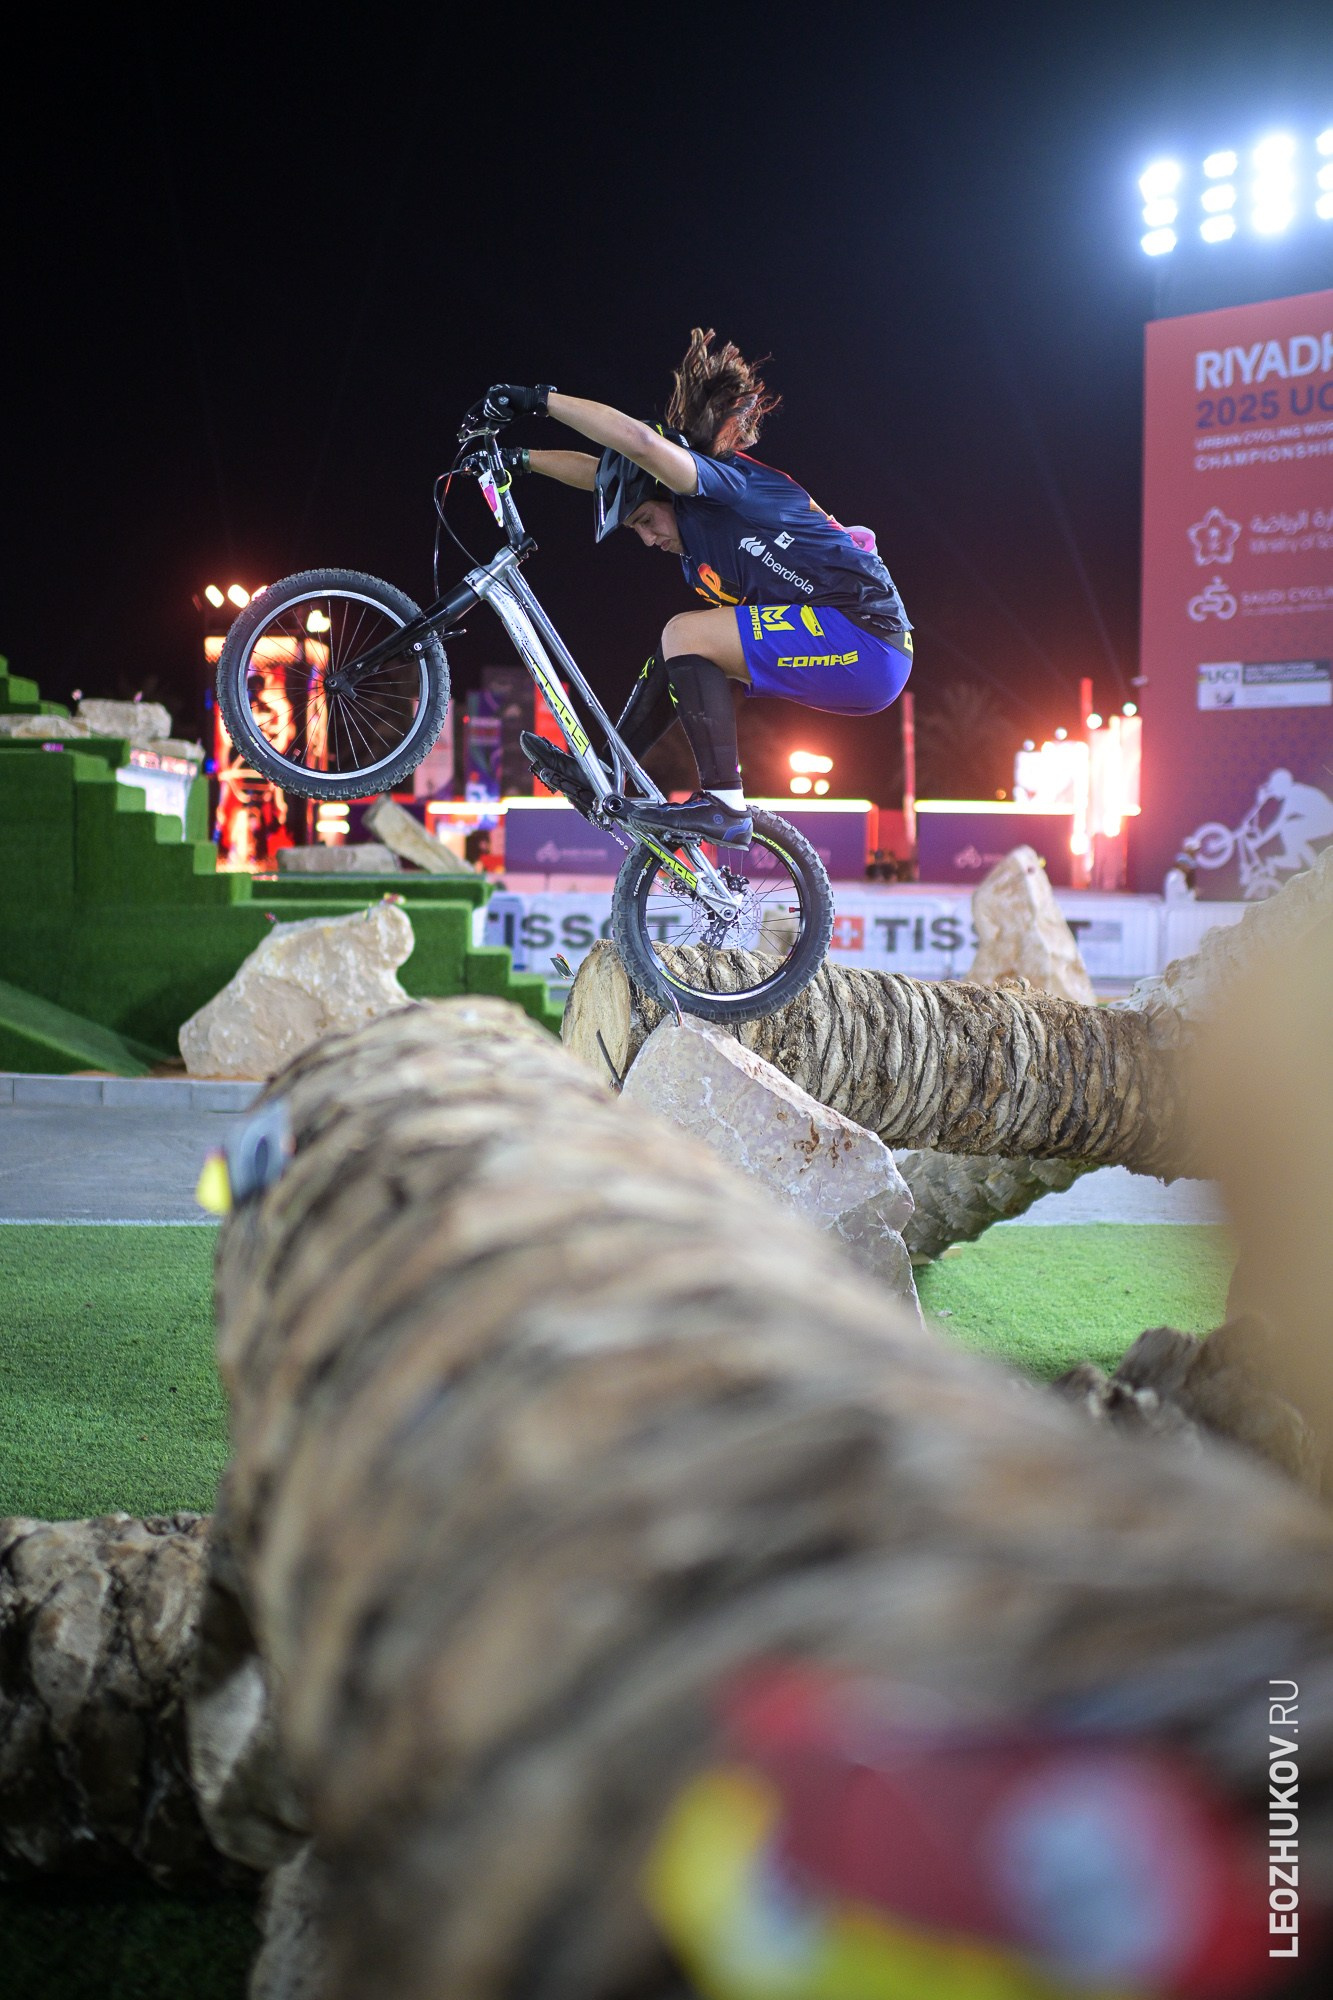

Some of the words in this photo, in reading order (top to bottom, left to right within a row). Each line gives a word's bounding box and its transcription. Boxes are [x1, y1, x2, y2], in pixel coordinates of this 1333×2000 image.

[1196, 389, 1281, 430] 2025
[1242, 425, 1302, 445] CYCLING
[762, 551, 814, 594] Iberdrola
[777, 650, 859, 668] COMAS
[1207, 669, 1239, 684] UCI
[488, 912, 681, 950] ISST
[874, 916, 1092, 952] TIST
